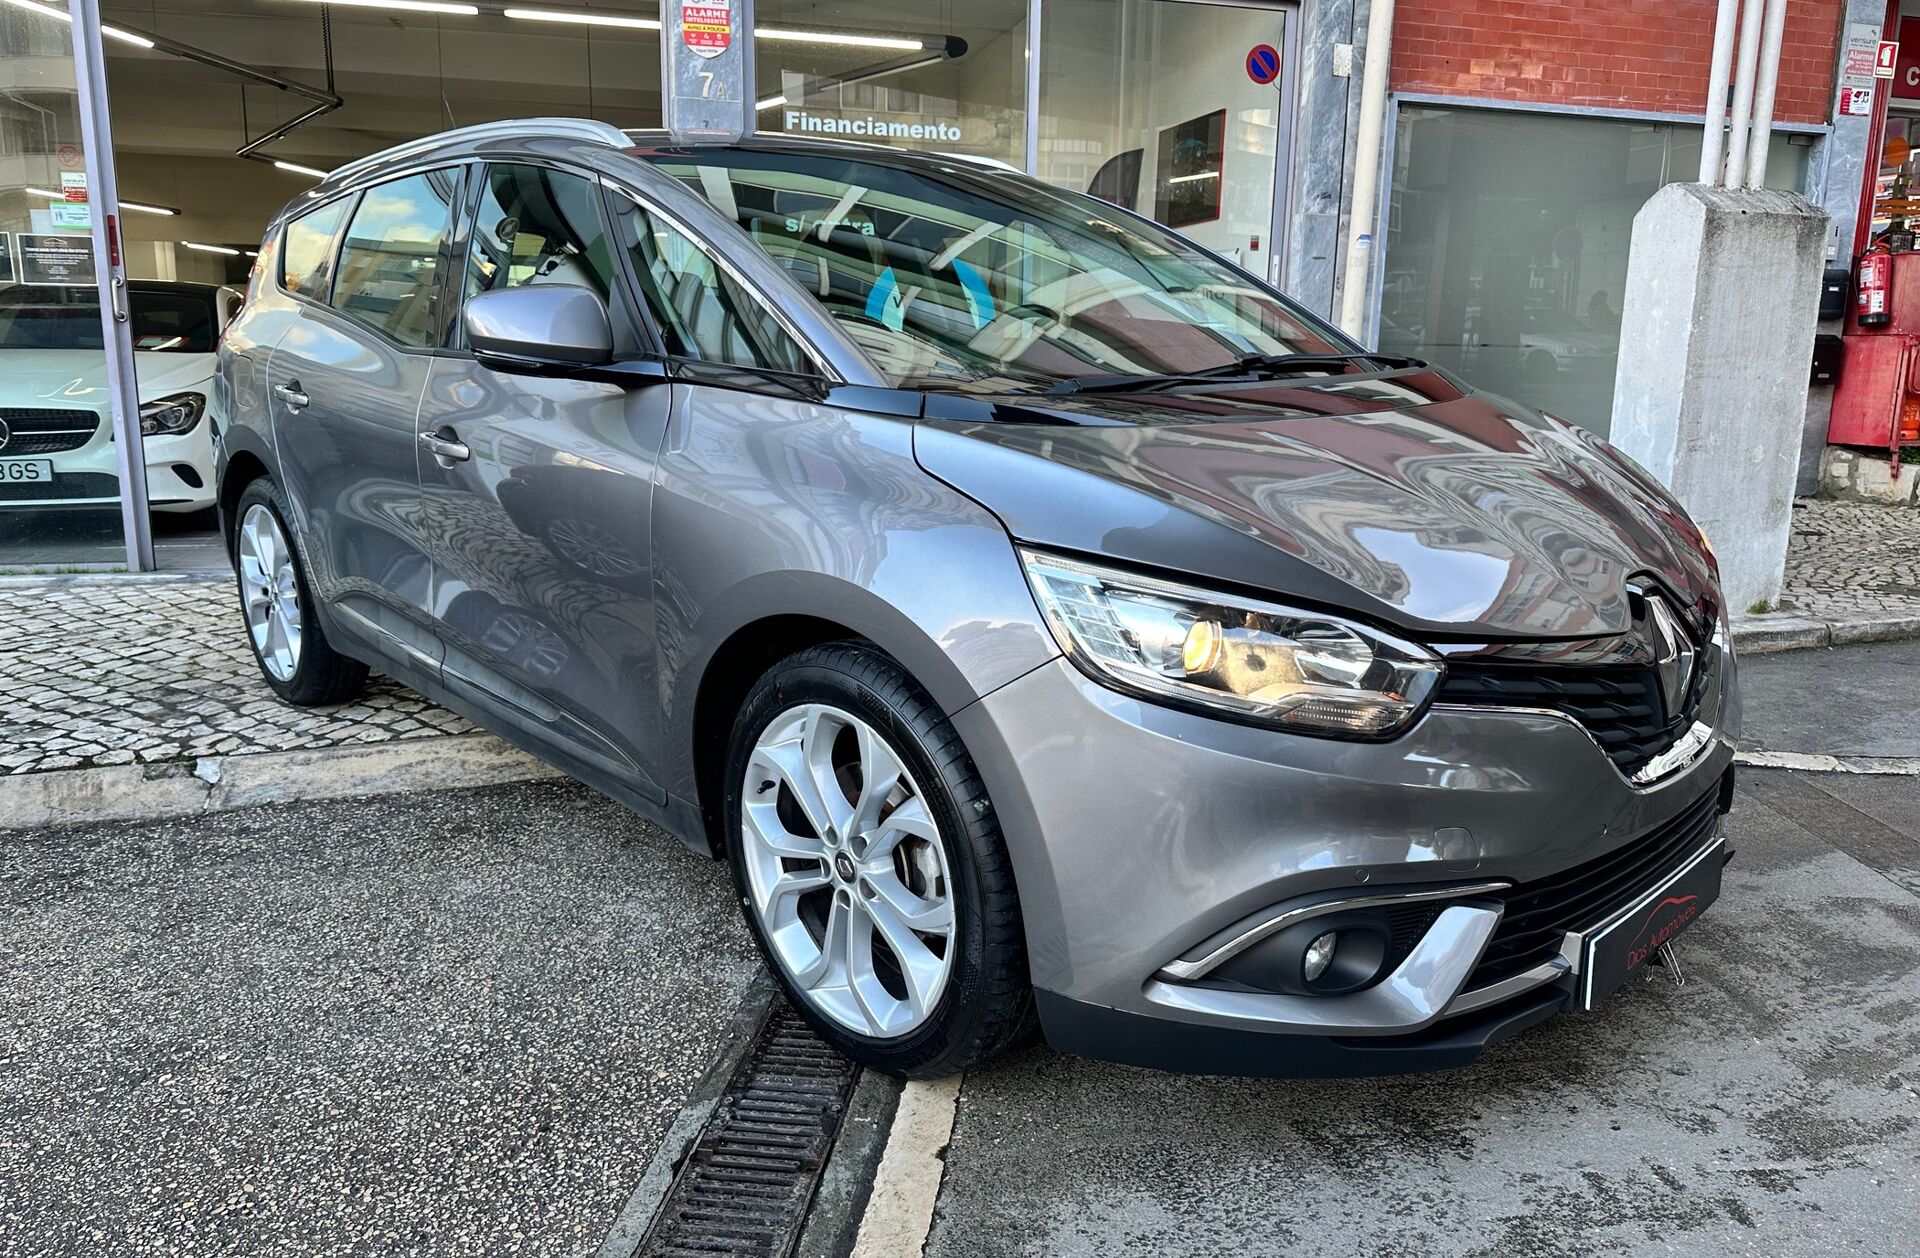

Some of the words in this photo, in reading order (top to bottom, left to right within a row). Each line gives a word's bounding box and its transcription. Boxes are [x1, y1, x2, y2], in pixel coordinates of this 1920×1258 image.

[685, 8, 727, 18] ALARME
[1849, 50, 1874, 61] Alarme
[785, 111, 961, 141] Financiamento
